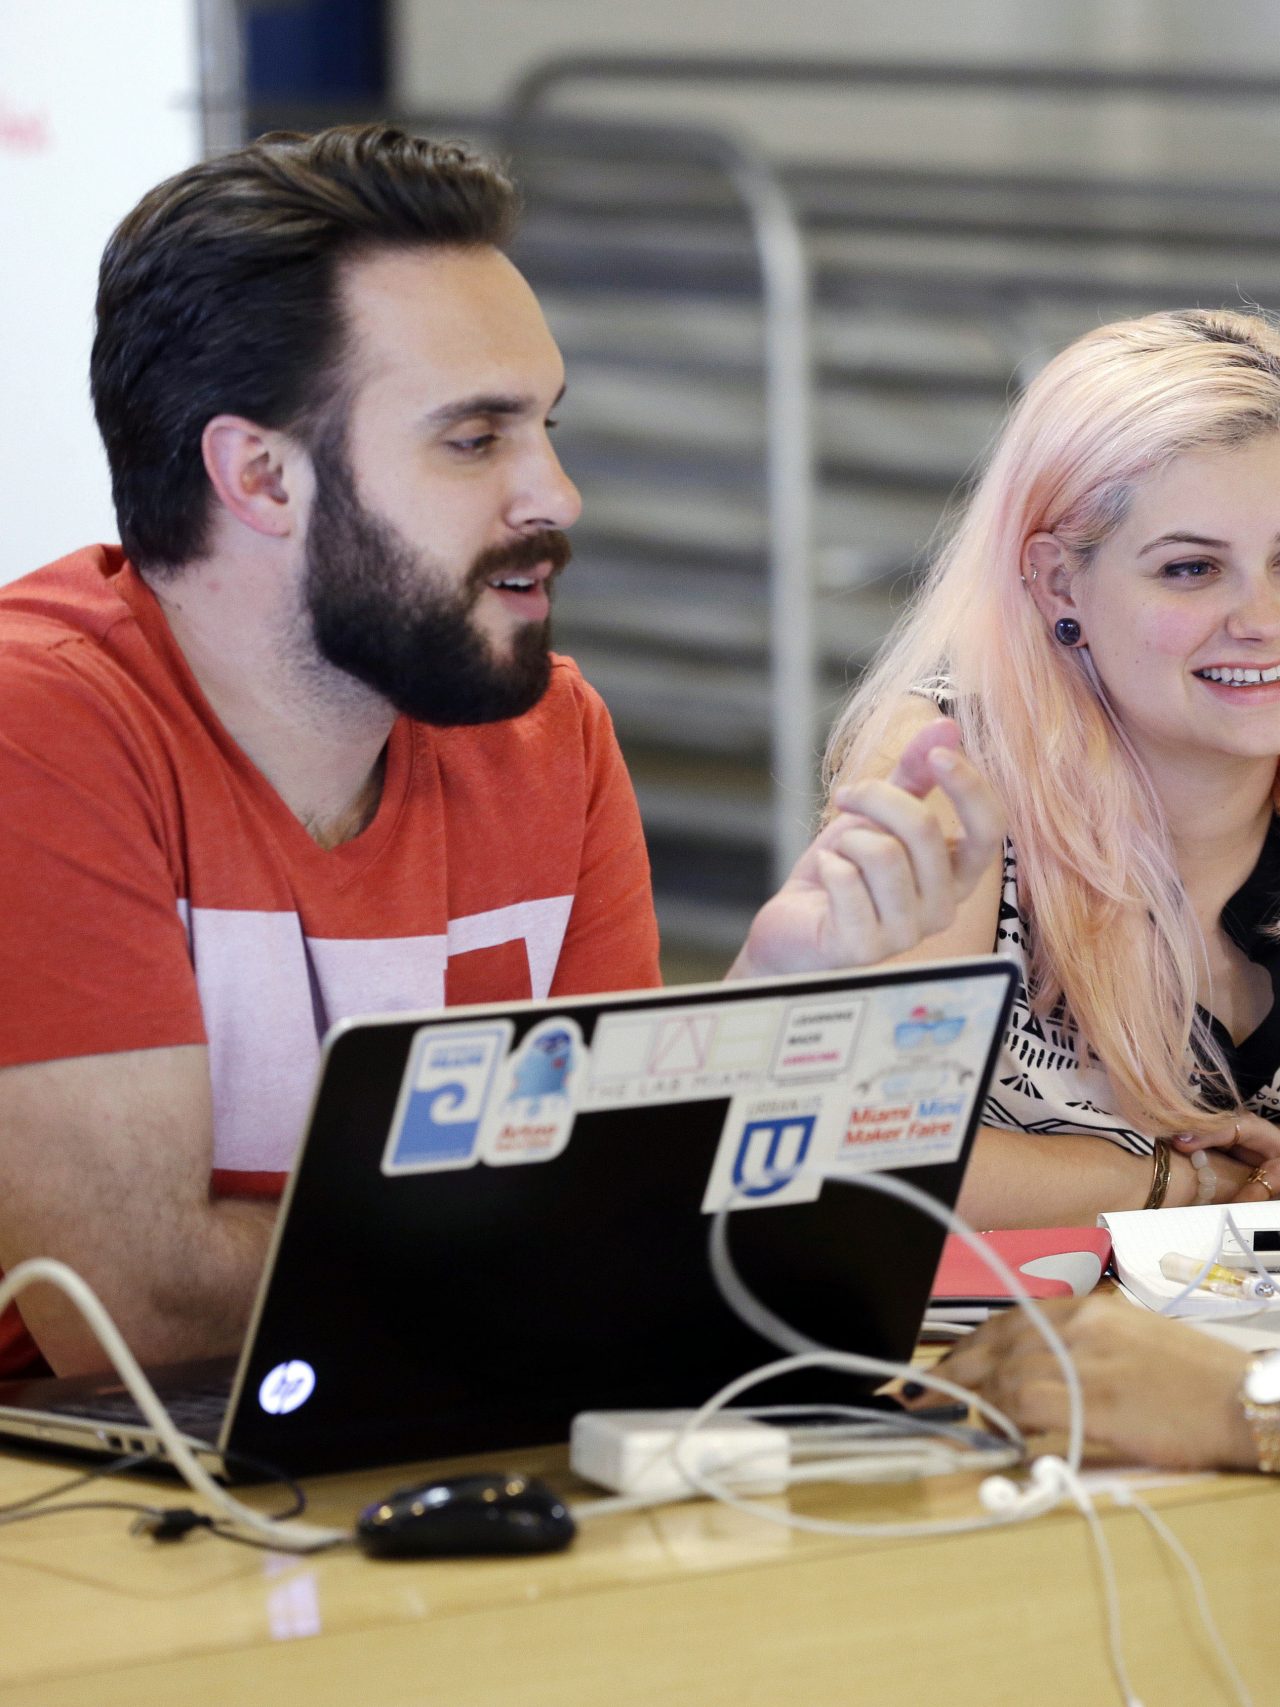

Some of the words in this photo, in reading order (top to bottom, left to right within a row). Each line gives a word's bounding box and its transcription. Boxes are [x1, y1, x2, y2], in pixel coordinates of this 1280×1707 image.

[849, 1102, 914, 1126] Miami
[917, 1094, 966, 1118] Mini
[845, 1126, 902, 1147] Maker
[907, 1118, 953, 1140] Faire
[262, 1360, 312, 1414] hp
